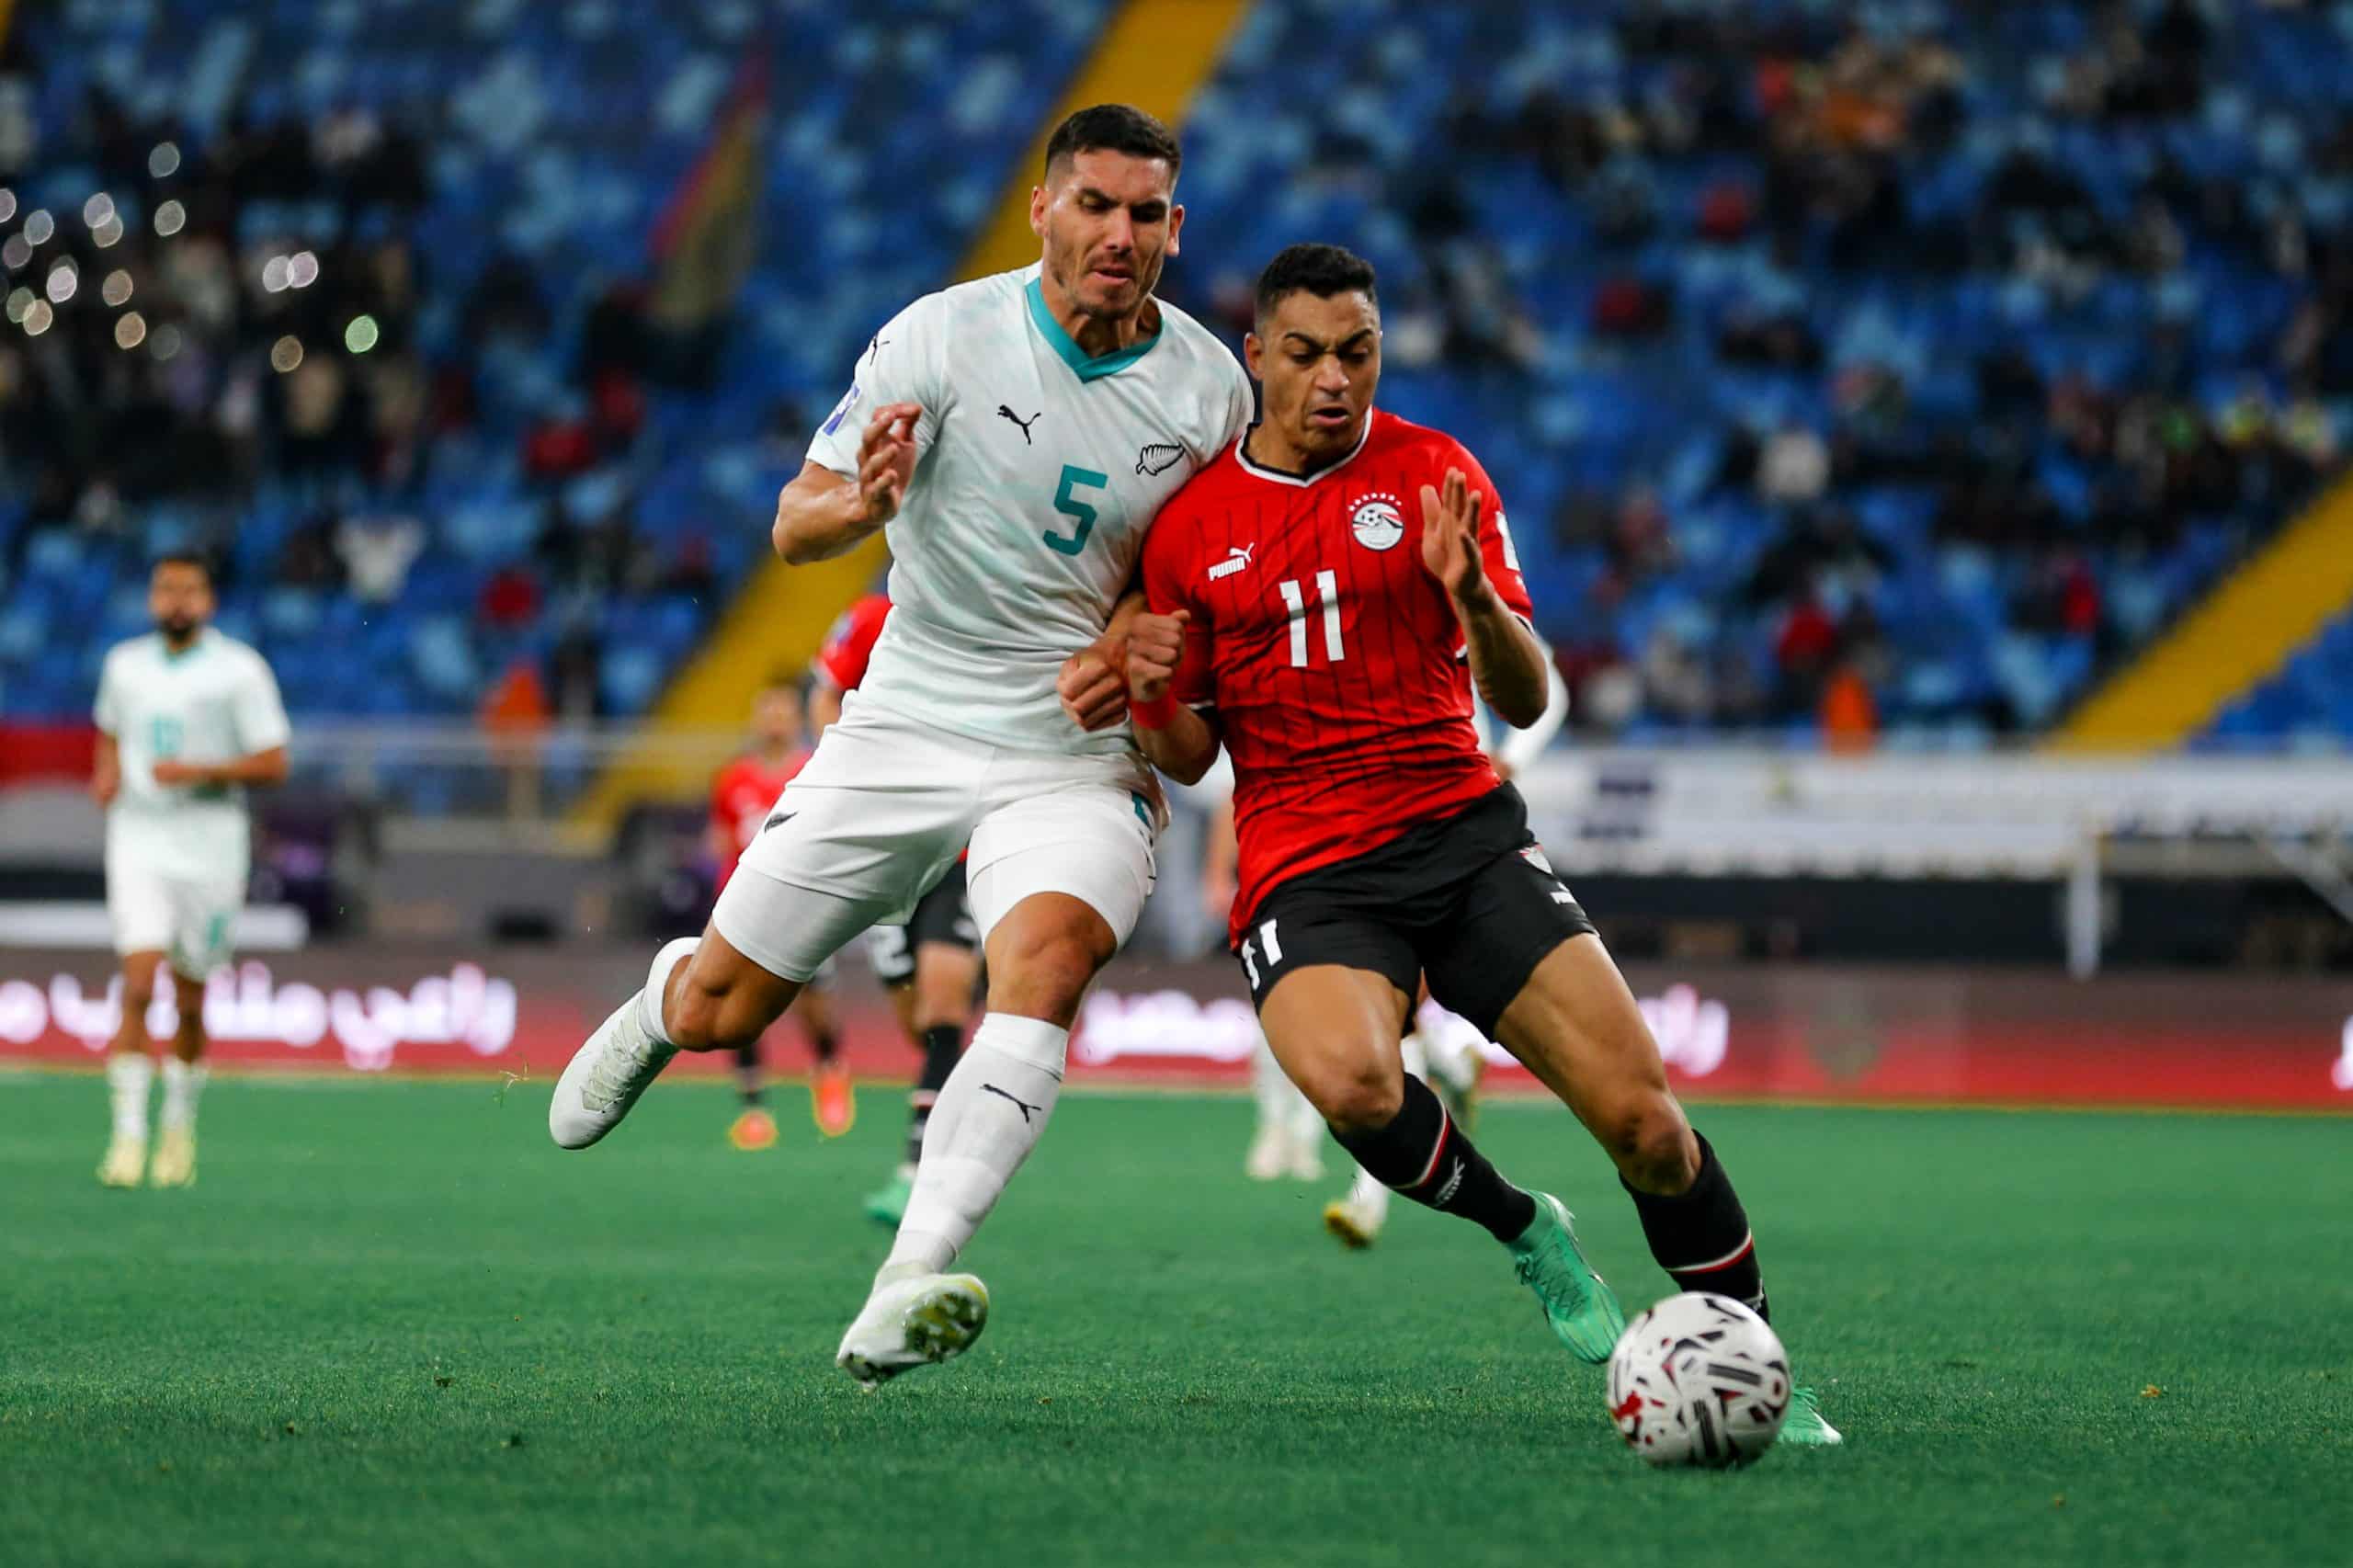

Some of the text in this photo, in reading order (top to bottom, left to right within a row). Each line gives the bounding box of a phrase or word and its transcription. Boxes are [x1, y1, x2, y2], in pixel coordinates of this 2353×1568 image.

[1042, 463, 1108, 557] 5
[1208, 556, 1246, 582] PUMA
[1279, 568, 1346, 668] 11
